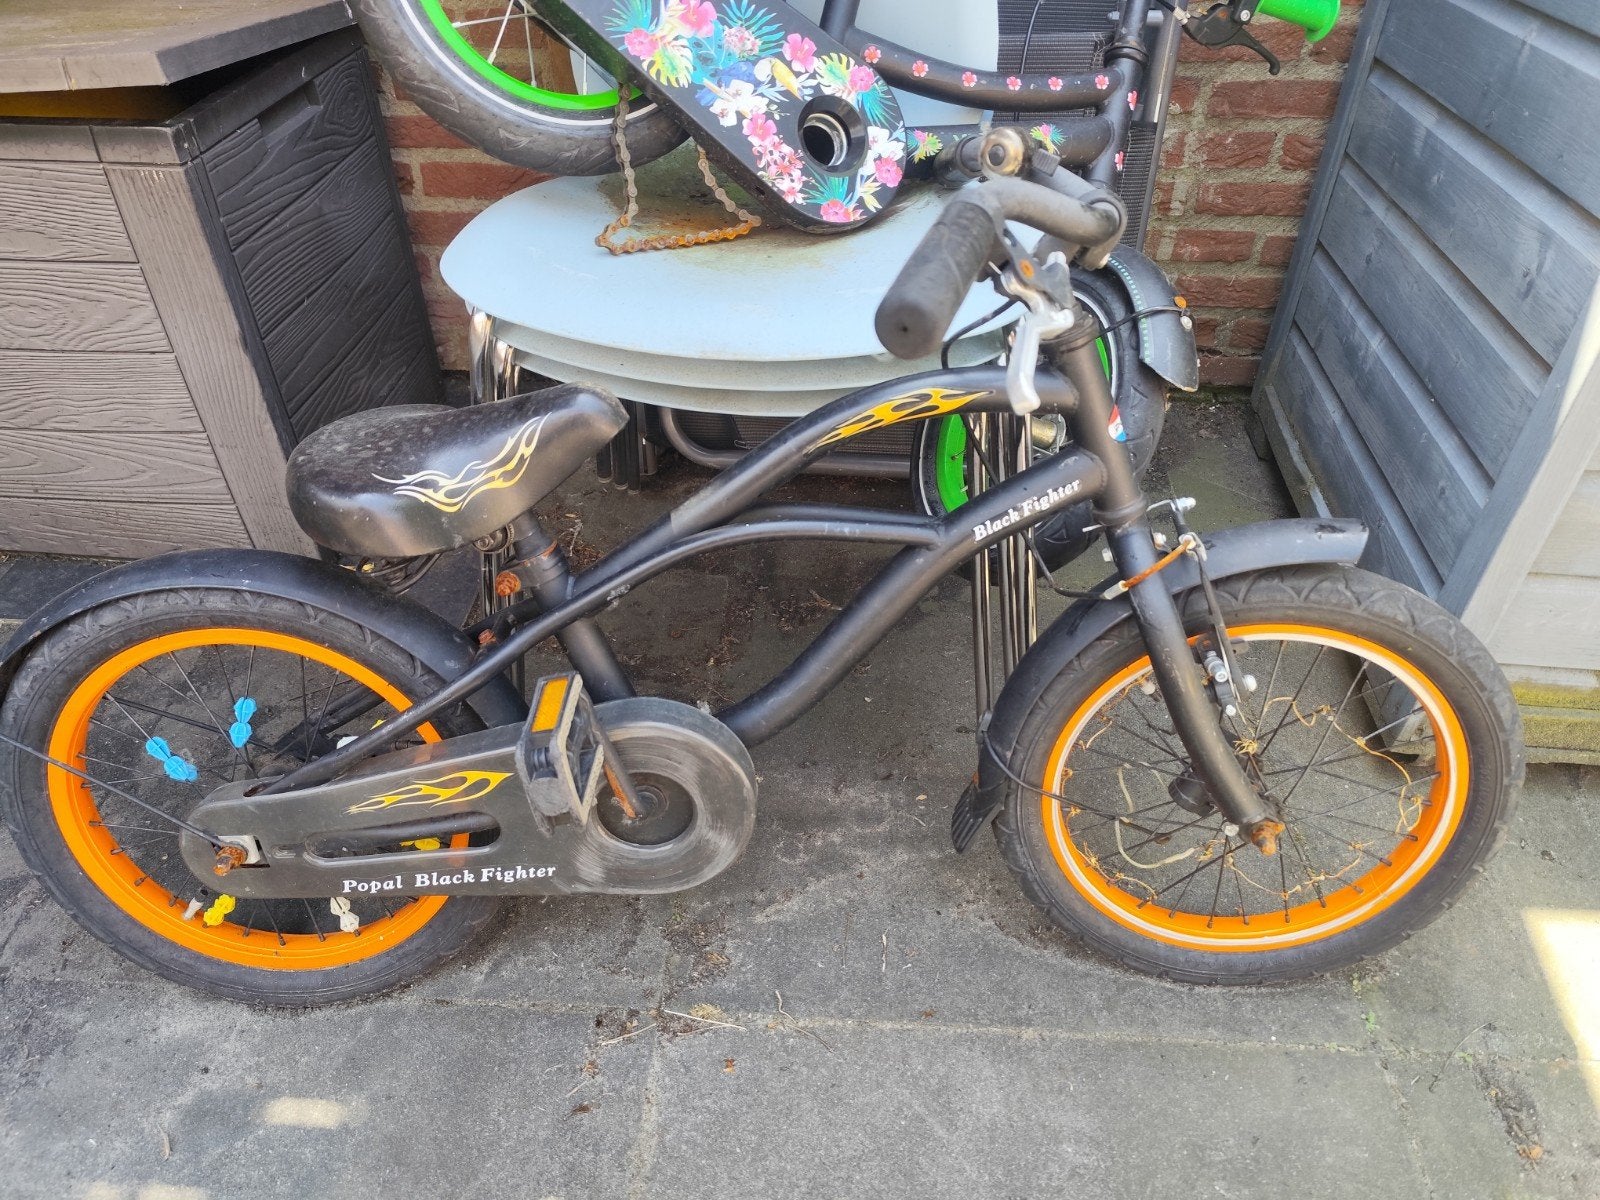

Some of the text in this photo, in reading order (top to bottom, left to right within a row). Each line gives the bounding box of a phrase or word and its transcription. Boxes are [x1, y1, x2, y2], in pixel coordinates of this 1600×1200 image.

[972, 480, 1080, 542] Black Fighter
[342, 865, 556, 894] Popal Black Fighter
